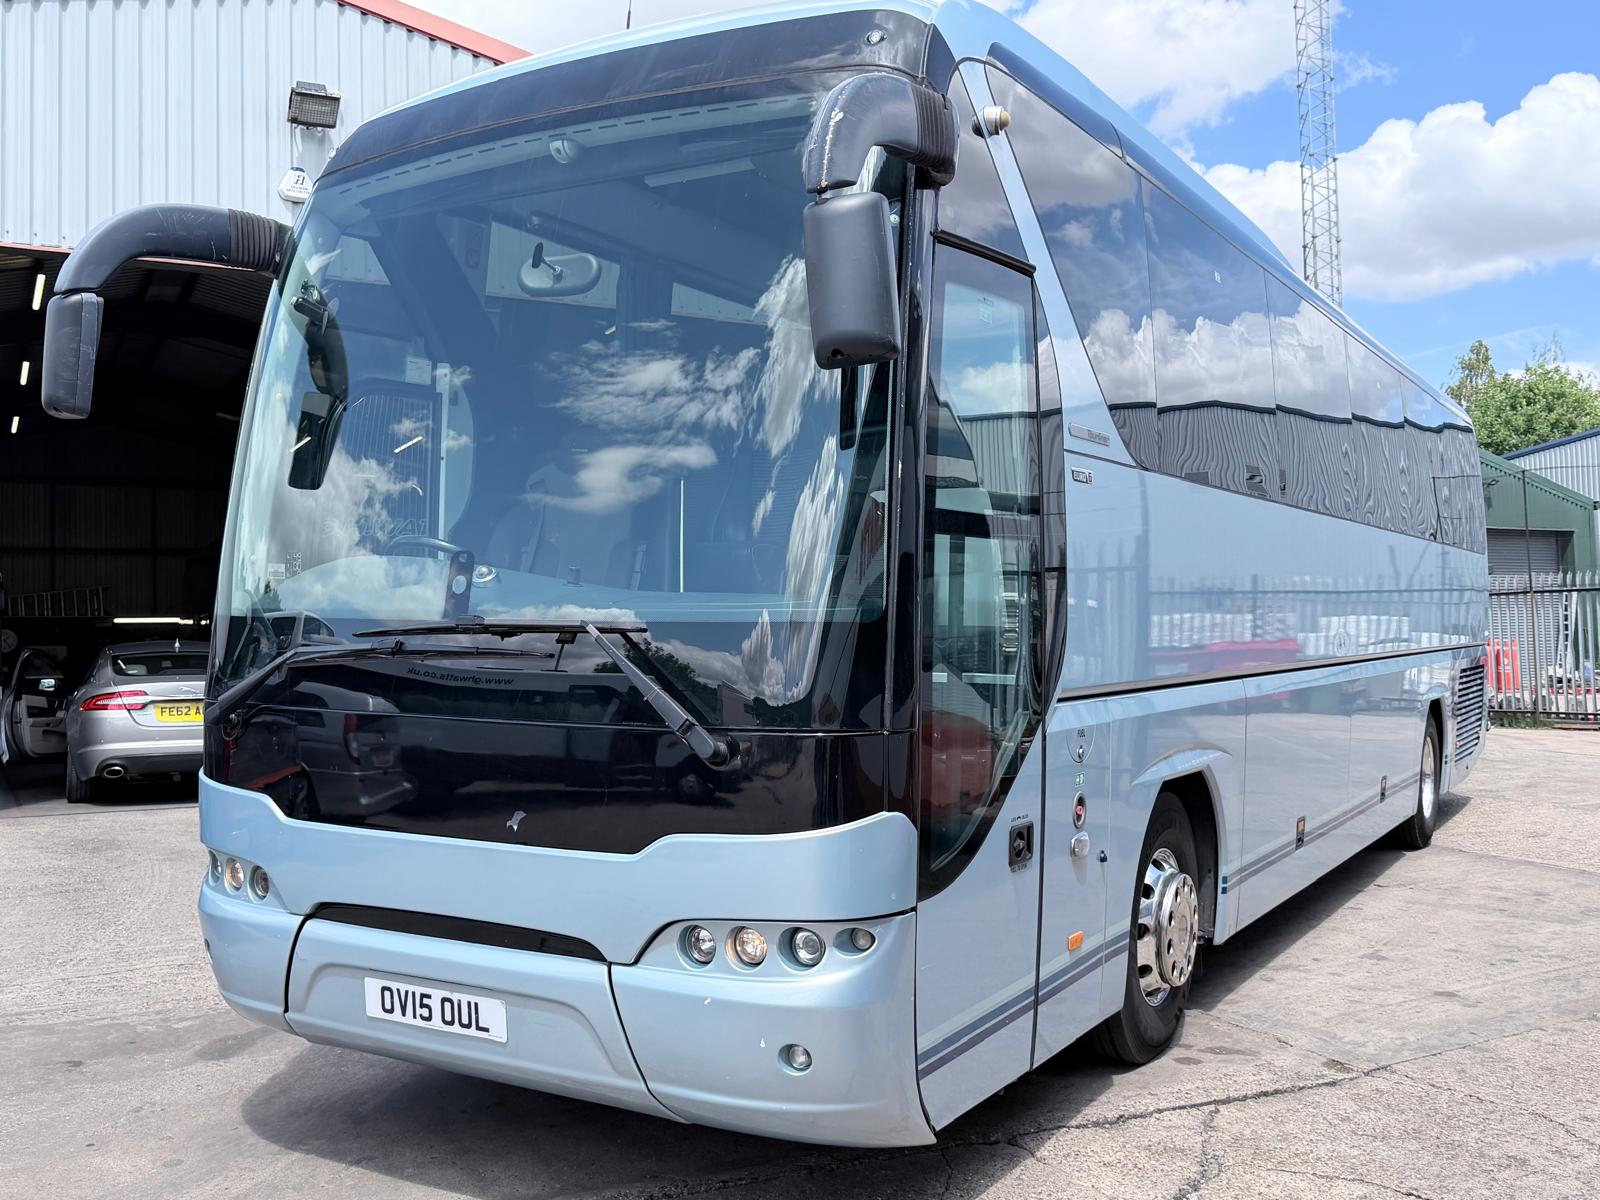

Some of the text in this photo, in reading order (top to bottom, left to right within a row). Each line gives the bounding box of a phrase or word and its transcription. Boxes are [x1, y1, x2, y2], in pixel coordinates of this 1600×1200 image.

[160, 706, 191, 716] FE62
[195, 706, 203, 716] A
[380, 985, 490, 1033] OV15 OUL
